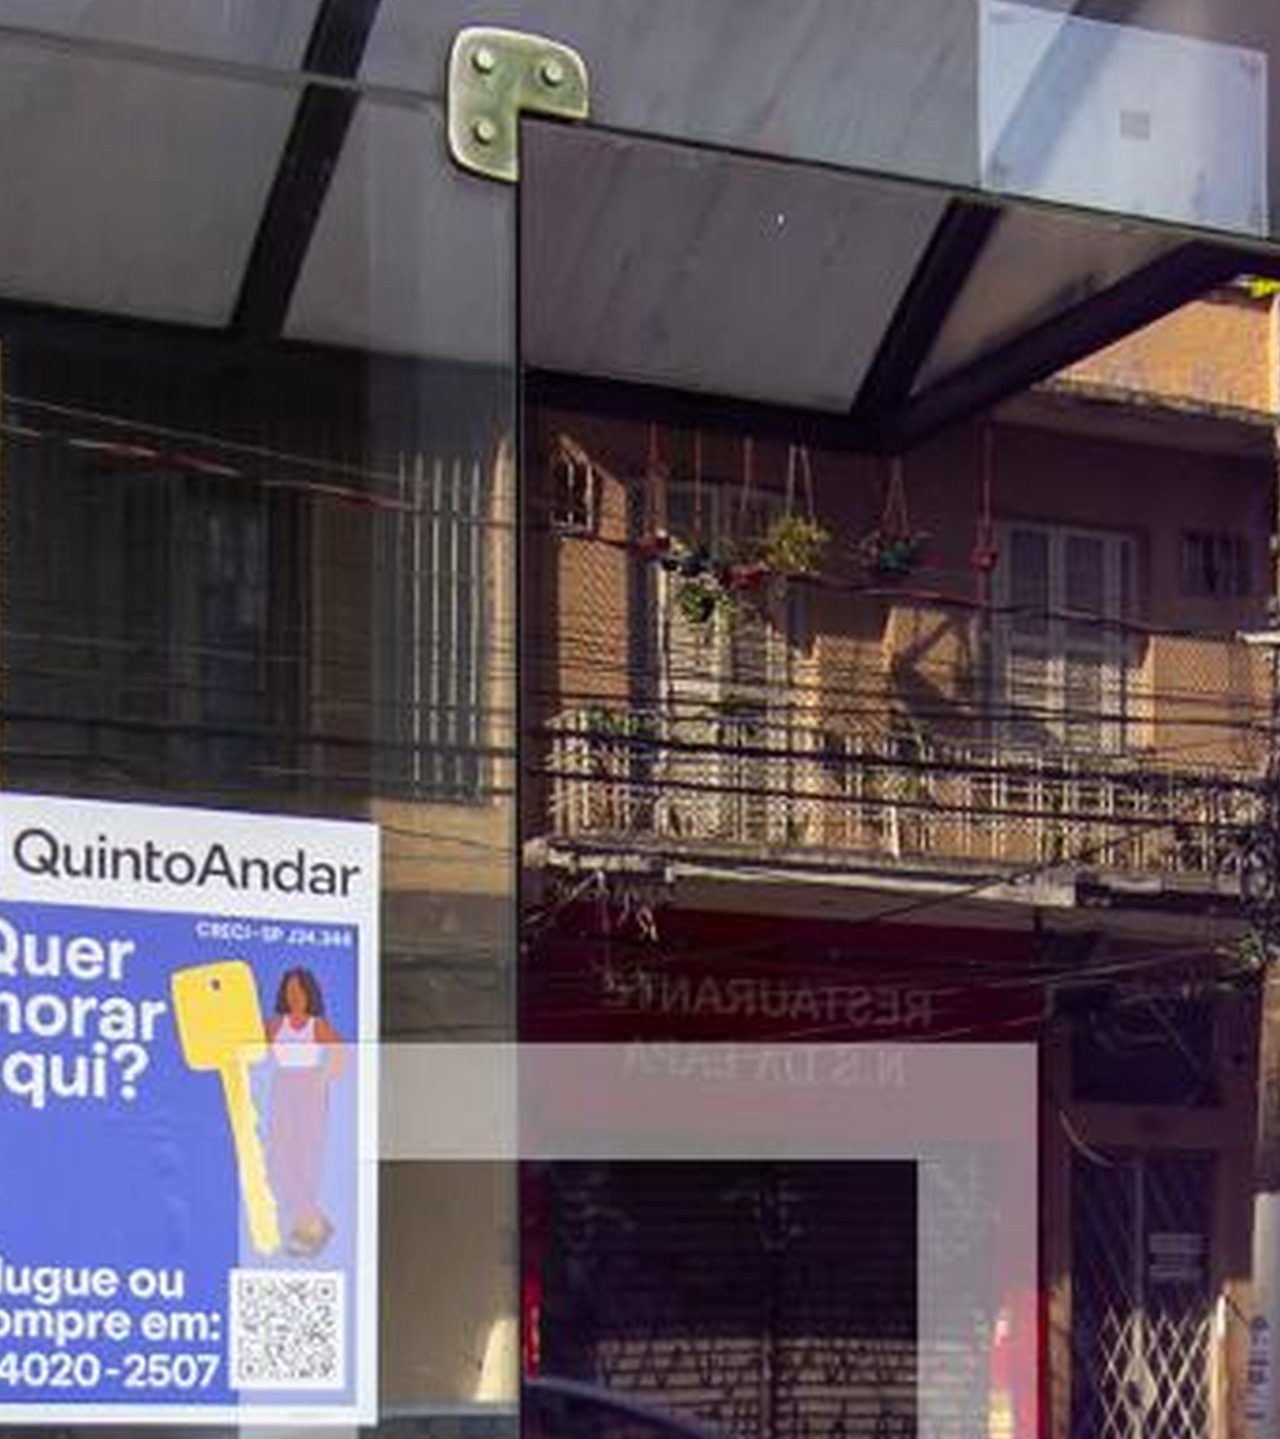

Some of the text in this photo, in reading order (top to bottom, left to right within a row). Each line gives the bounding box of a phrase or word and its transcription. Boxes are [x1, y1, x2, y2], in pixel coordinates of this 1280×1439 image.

[12, 827, 361, 899] QuintoAndar
[128, 1264, 185, 1299] ou
[145, 1309, 222, 1343] em:
